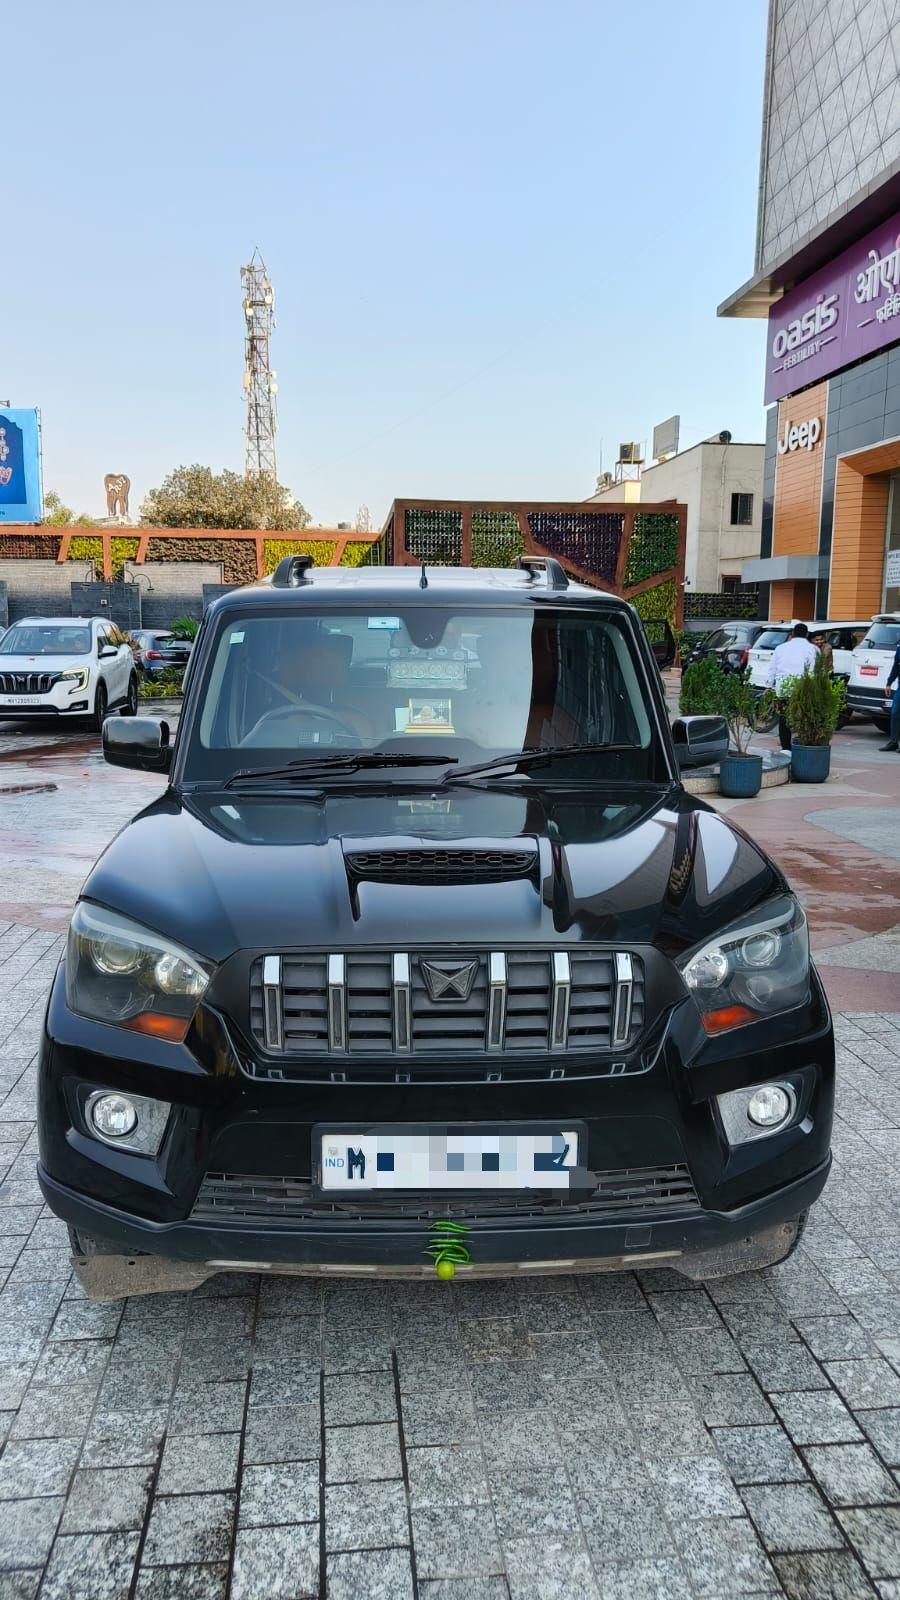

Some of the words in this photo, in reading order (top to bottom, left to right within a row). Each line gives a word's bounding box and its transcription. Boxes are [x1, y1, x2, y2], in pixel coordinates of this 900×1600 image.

[772, 294, 839, 359] oasis
[783, 340, 821, 370] FERTILITY
[779, 415, 822, 455] Jeep
[325, 1157, 345, 1168] IND
